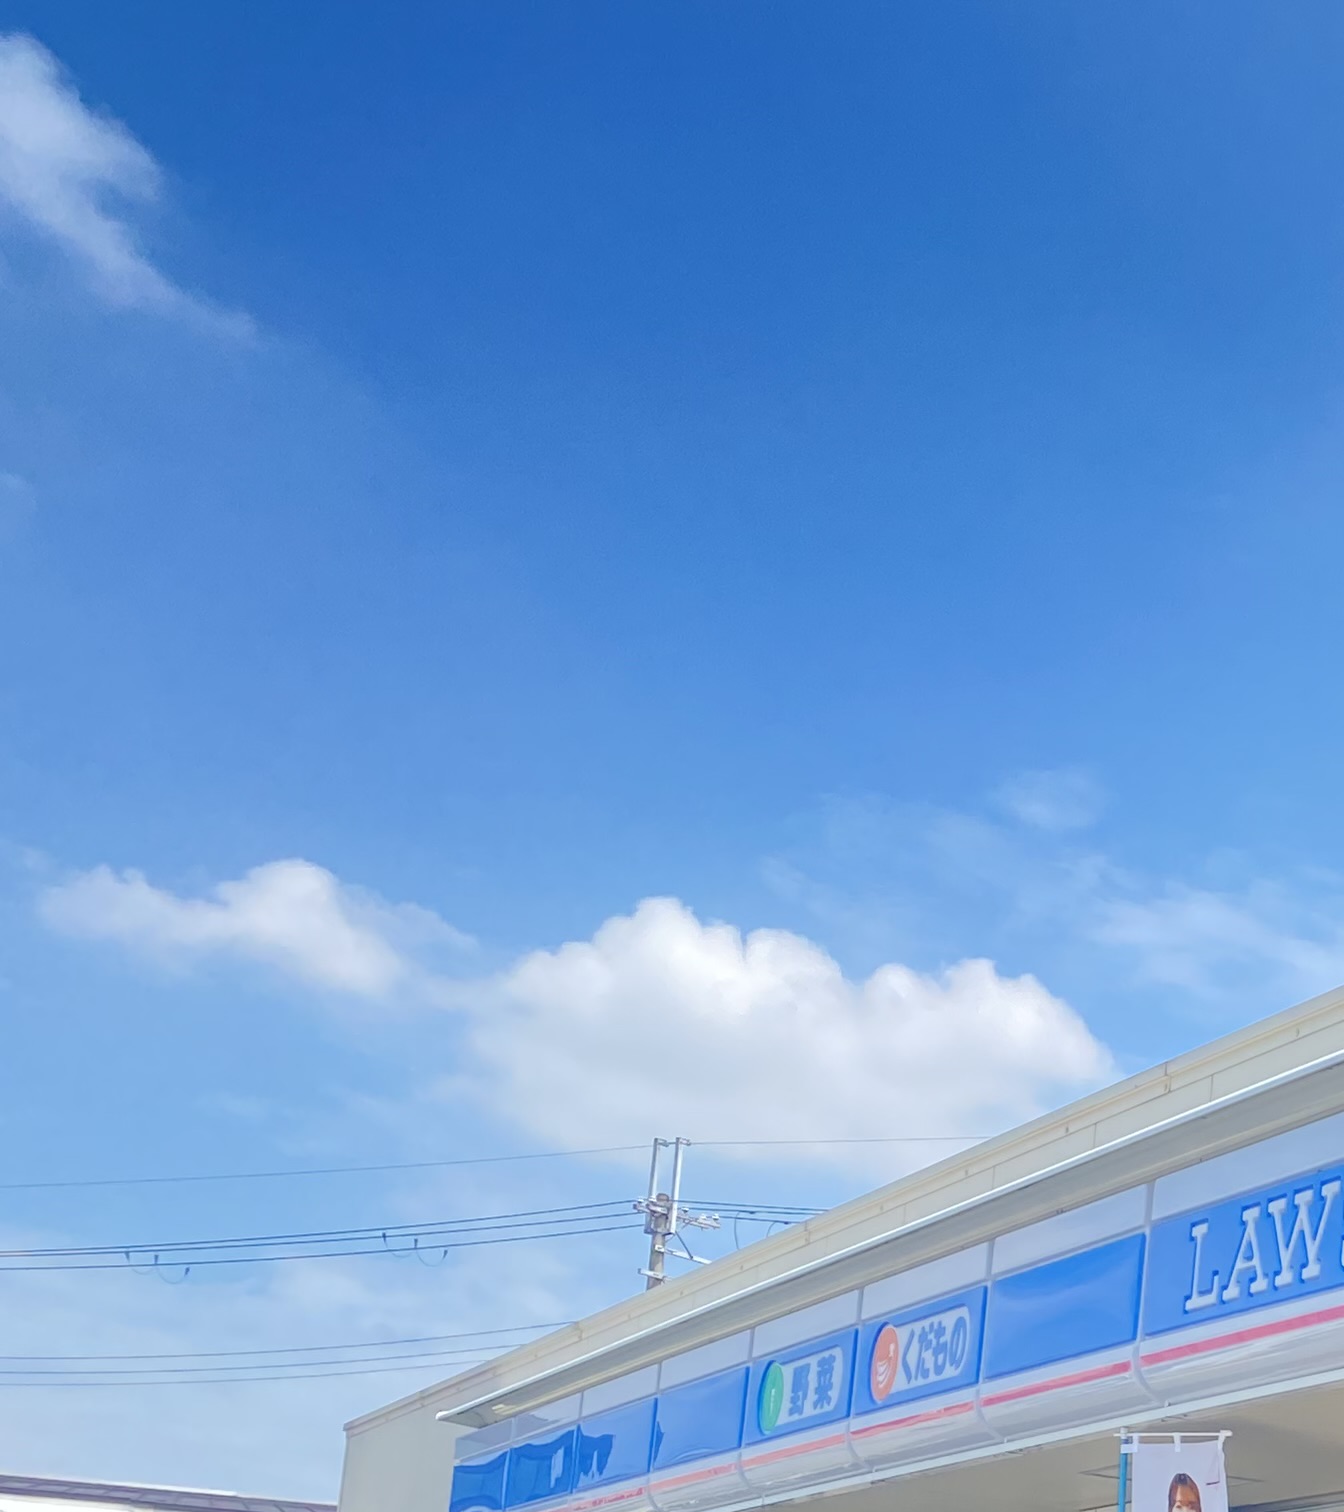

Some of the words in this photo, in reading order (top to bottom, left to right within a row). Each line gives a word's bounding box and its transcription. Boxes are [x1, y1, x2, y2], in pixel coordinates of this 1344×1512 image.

[902, 1316, 967, 1384] くだもの
[788, 1353, 836, 1417] 野菜
